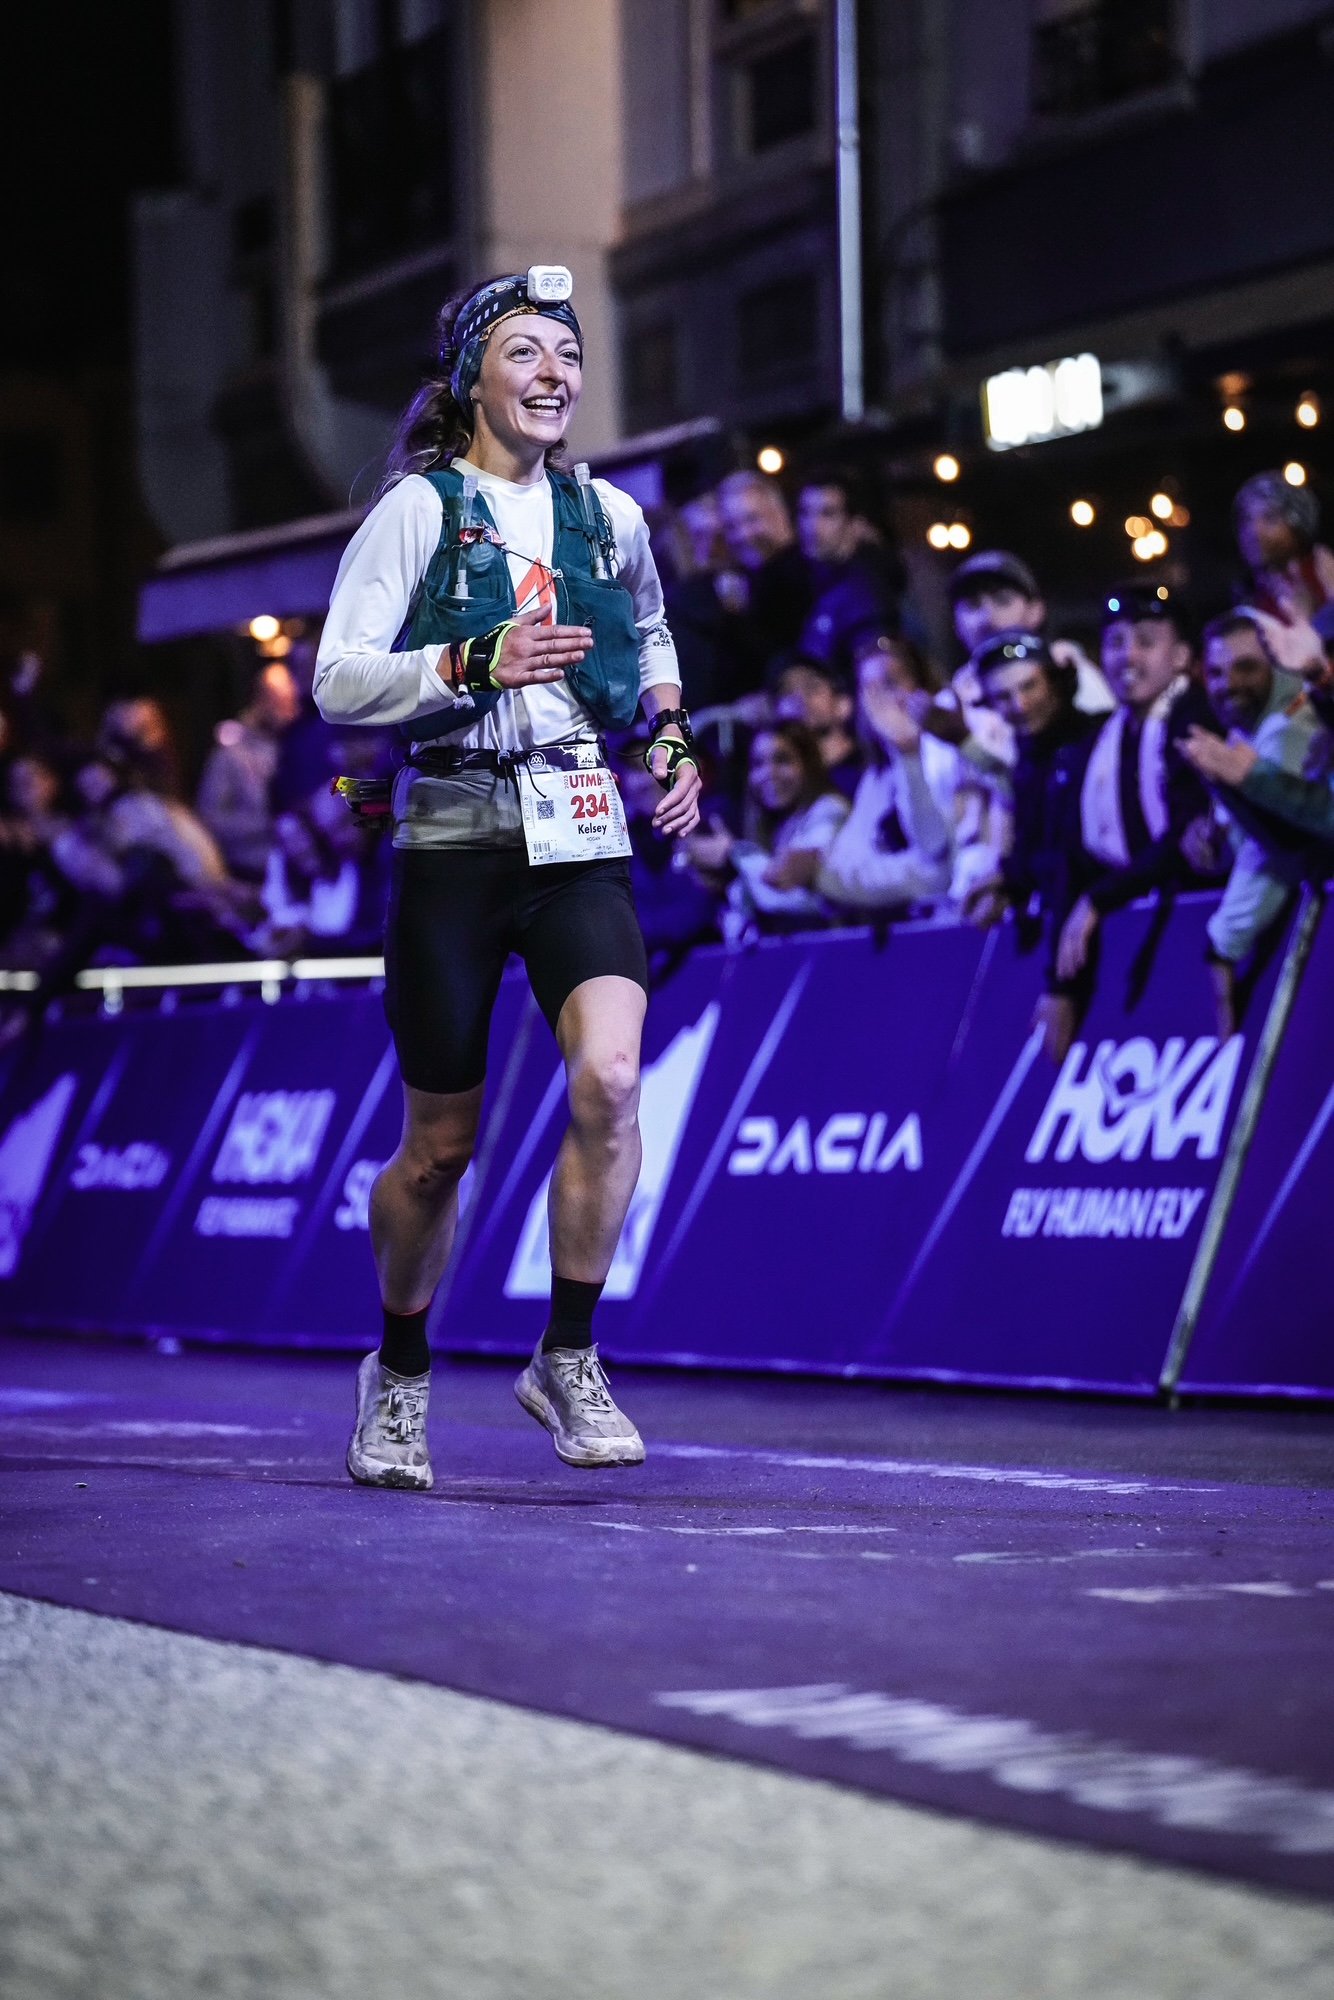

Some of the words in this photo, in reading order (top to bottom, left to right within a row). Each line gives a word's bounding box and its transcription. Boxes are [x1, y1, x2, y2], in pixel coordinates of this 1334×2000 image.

[570, 793, 609, 819] 234
[577, 822, 608, 836] Kelsey
[1024, 1034, 1243, 1164] HOKA
[727, 1112, 923, 1176] DACIA
[1001, 1187, 1051, 1238] FLY
[1042, 1187, 1155, 1238] HUMAN
[1145, 1187, 1206, 1239] FLY
